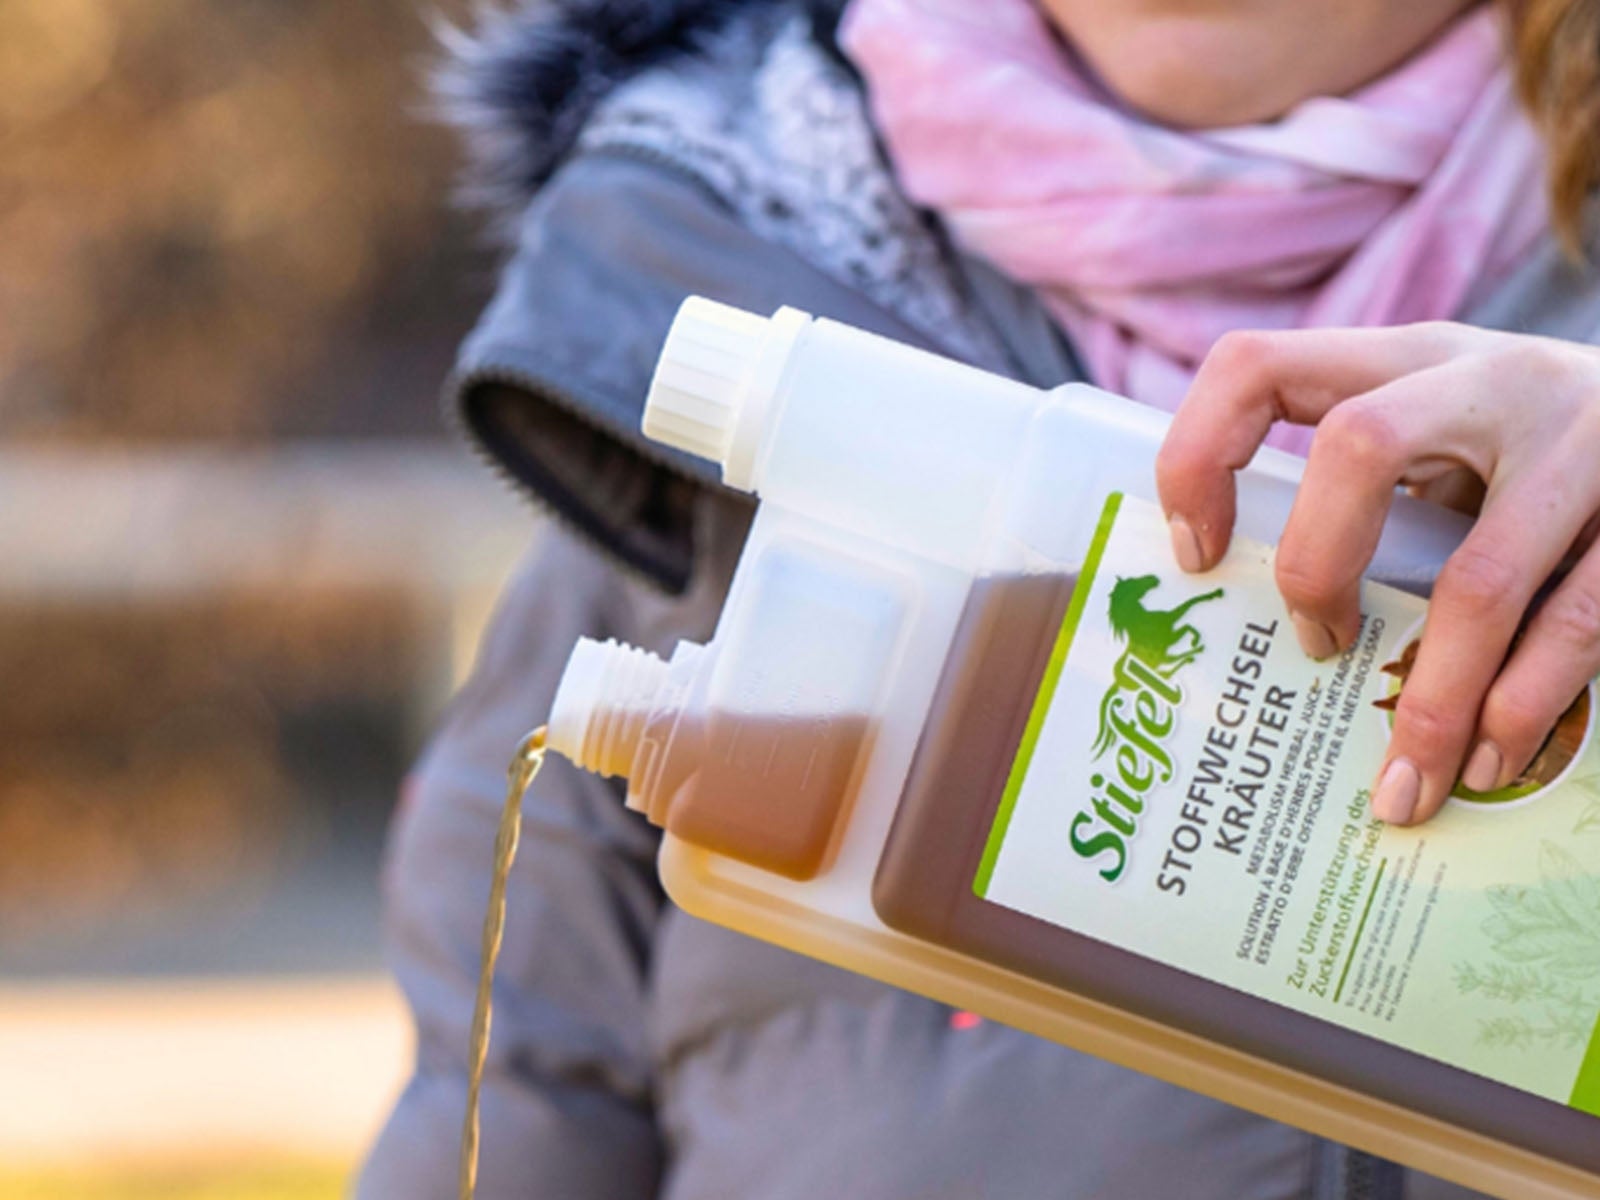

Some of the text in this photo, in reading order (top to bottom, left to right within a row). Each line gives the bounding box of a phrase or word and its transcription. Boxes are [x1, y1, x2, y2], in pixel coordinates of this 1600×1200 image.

[1070, 656, 1181, 881] Stiefel
[1156, 618, 1279, 895] STOFFWECHSEL
[1213, 686, 1296, 854] KRÄUTER
[1238, 891, 1269, 958] SOLUTION
[1267, 841, 1286, 874] BASE
[1279, 771, 1311, 837] D'HERBES
[1304, 730, 1325, 768] POUR
[1318, 712, 1332, 726] LE
[1247, 783, 1287, 874] METABOLISM
[1279, 727, 1306, 779] HERBAL
[1257, 896, 1287, 963] ESTRATTO
[1298, 767, 1333, 843] OFFICINALI
[1325, 738, 1342, 764] PER
[1341, 617, 1385, 721] METABOLISMO
[1286, 787, 1369, 989] Zur Unterstützung des
